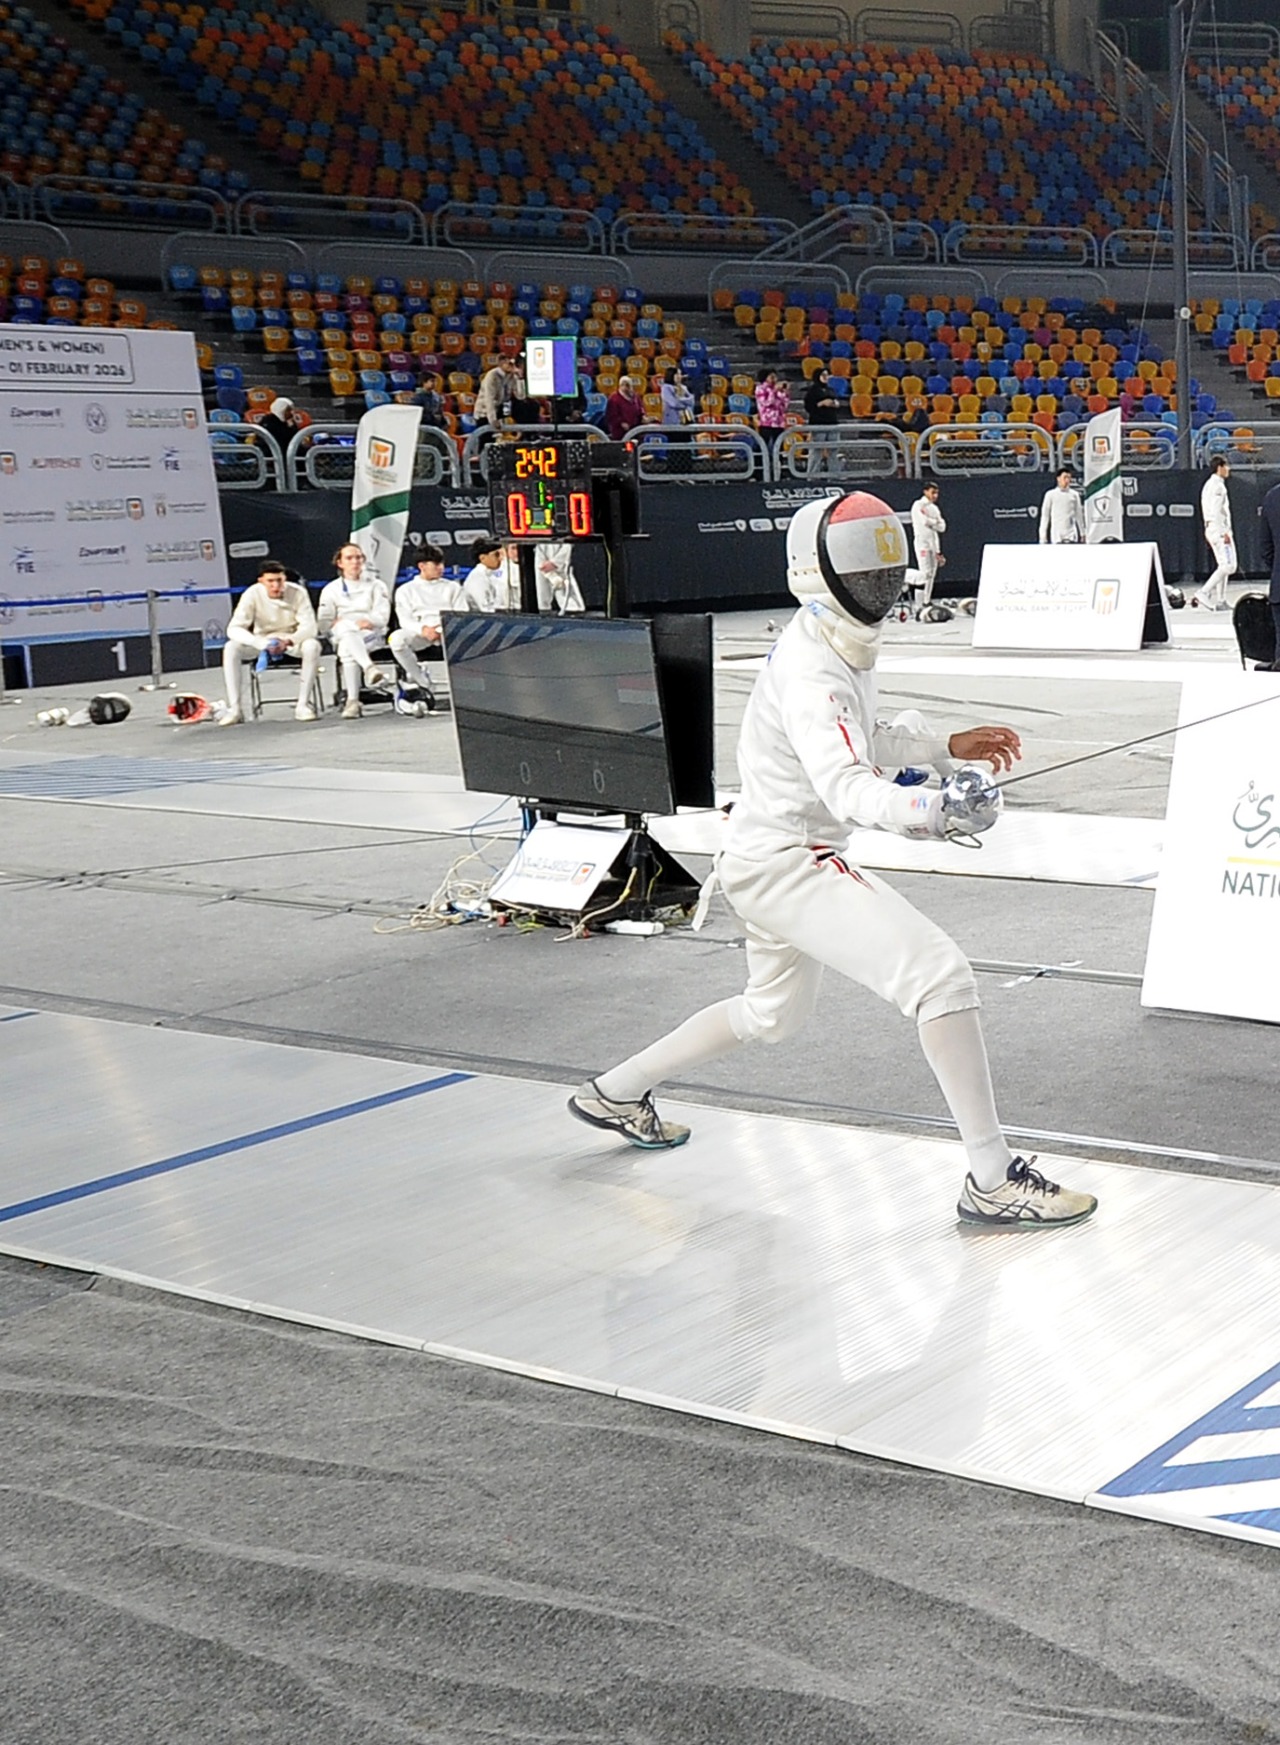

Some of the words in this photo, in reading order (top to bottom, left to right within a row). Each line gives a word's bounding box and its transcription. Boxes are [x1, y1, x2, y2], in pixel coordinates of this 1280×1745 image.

[26, 362, 90, 375] FEBRUARY
[94, 364, 126, 376] 2026
[515, 447, 557, 478] 2:42
[508, 493, 527, 535] 0
[569, 493, 591, 535] 0
[111, 641, 127, 672] 1
